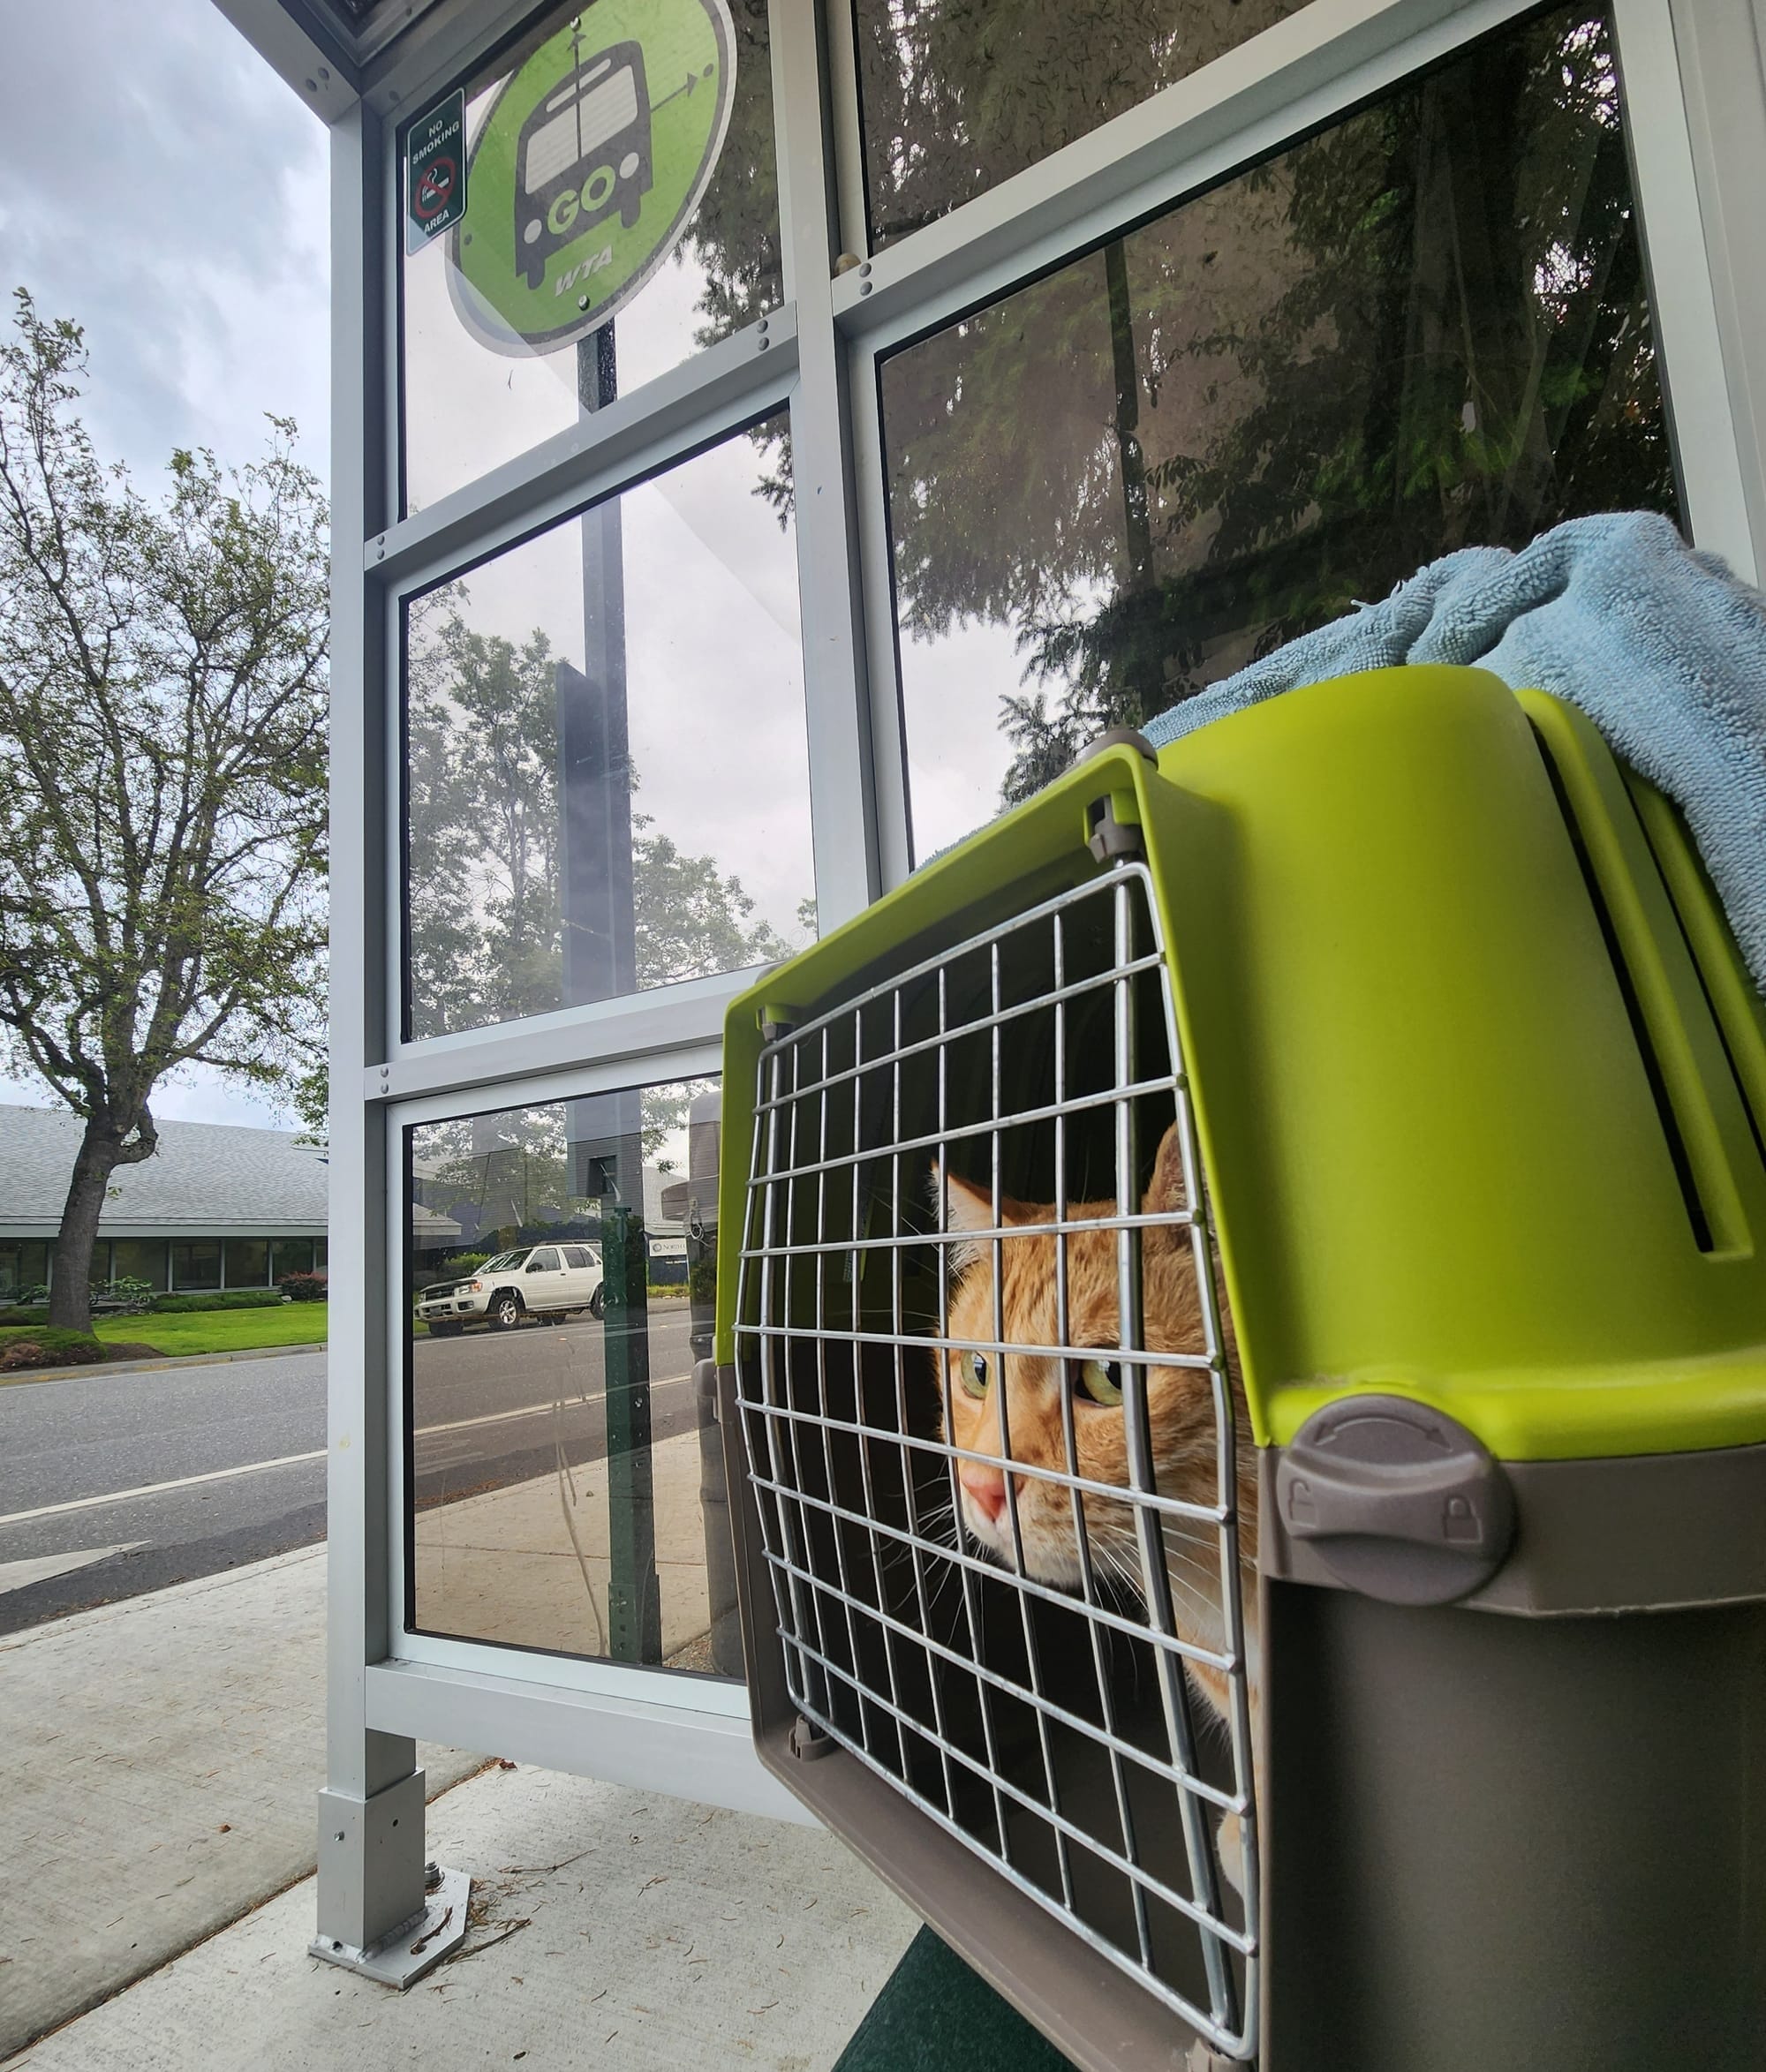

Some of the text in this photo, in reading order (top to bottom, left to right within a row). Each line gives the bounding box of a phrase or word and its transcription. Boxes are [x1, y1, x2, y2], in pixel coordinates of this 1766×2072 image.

[412, 121, 460, 165] SMOKING
[428, 119, 443, 138] NO
[424, 209, 449, 234] AREA
[547, 165, 616, 235] GO
[555, 245, 613, 297] WTA
